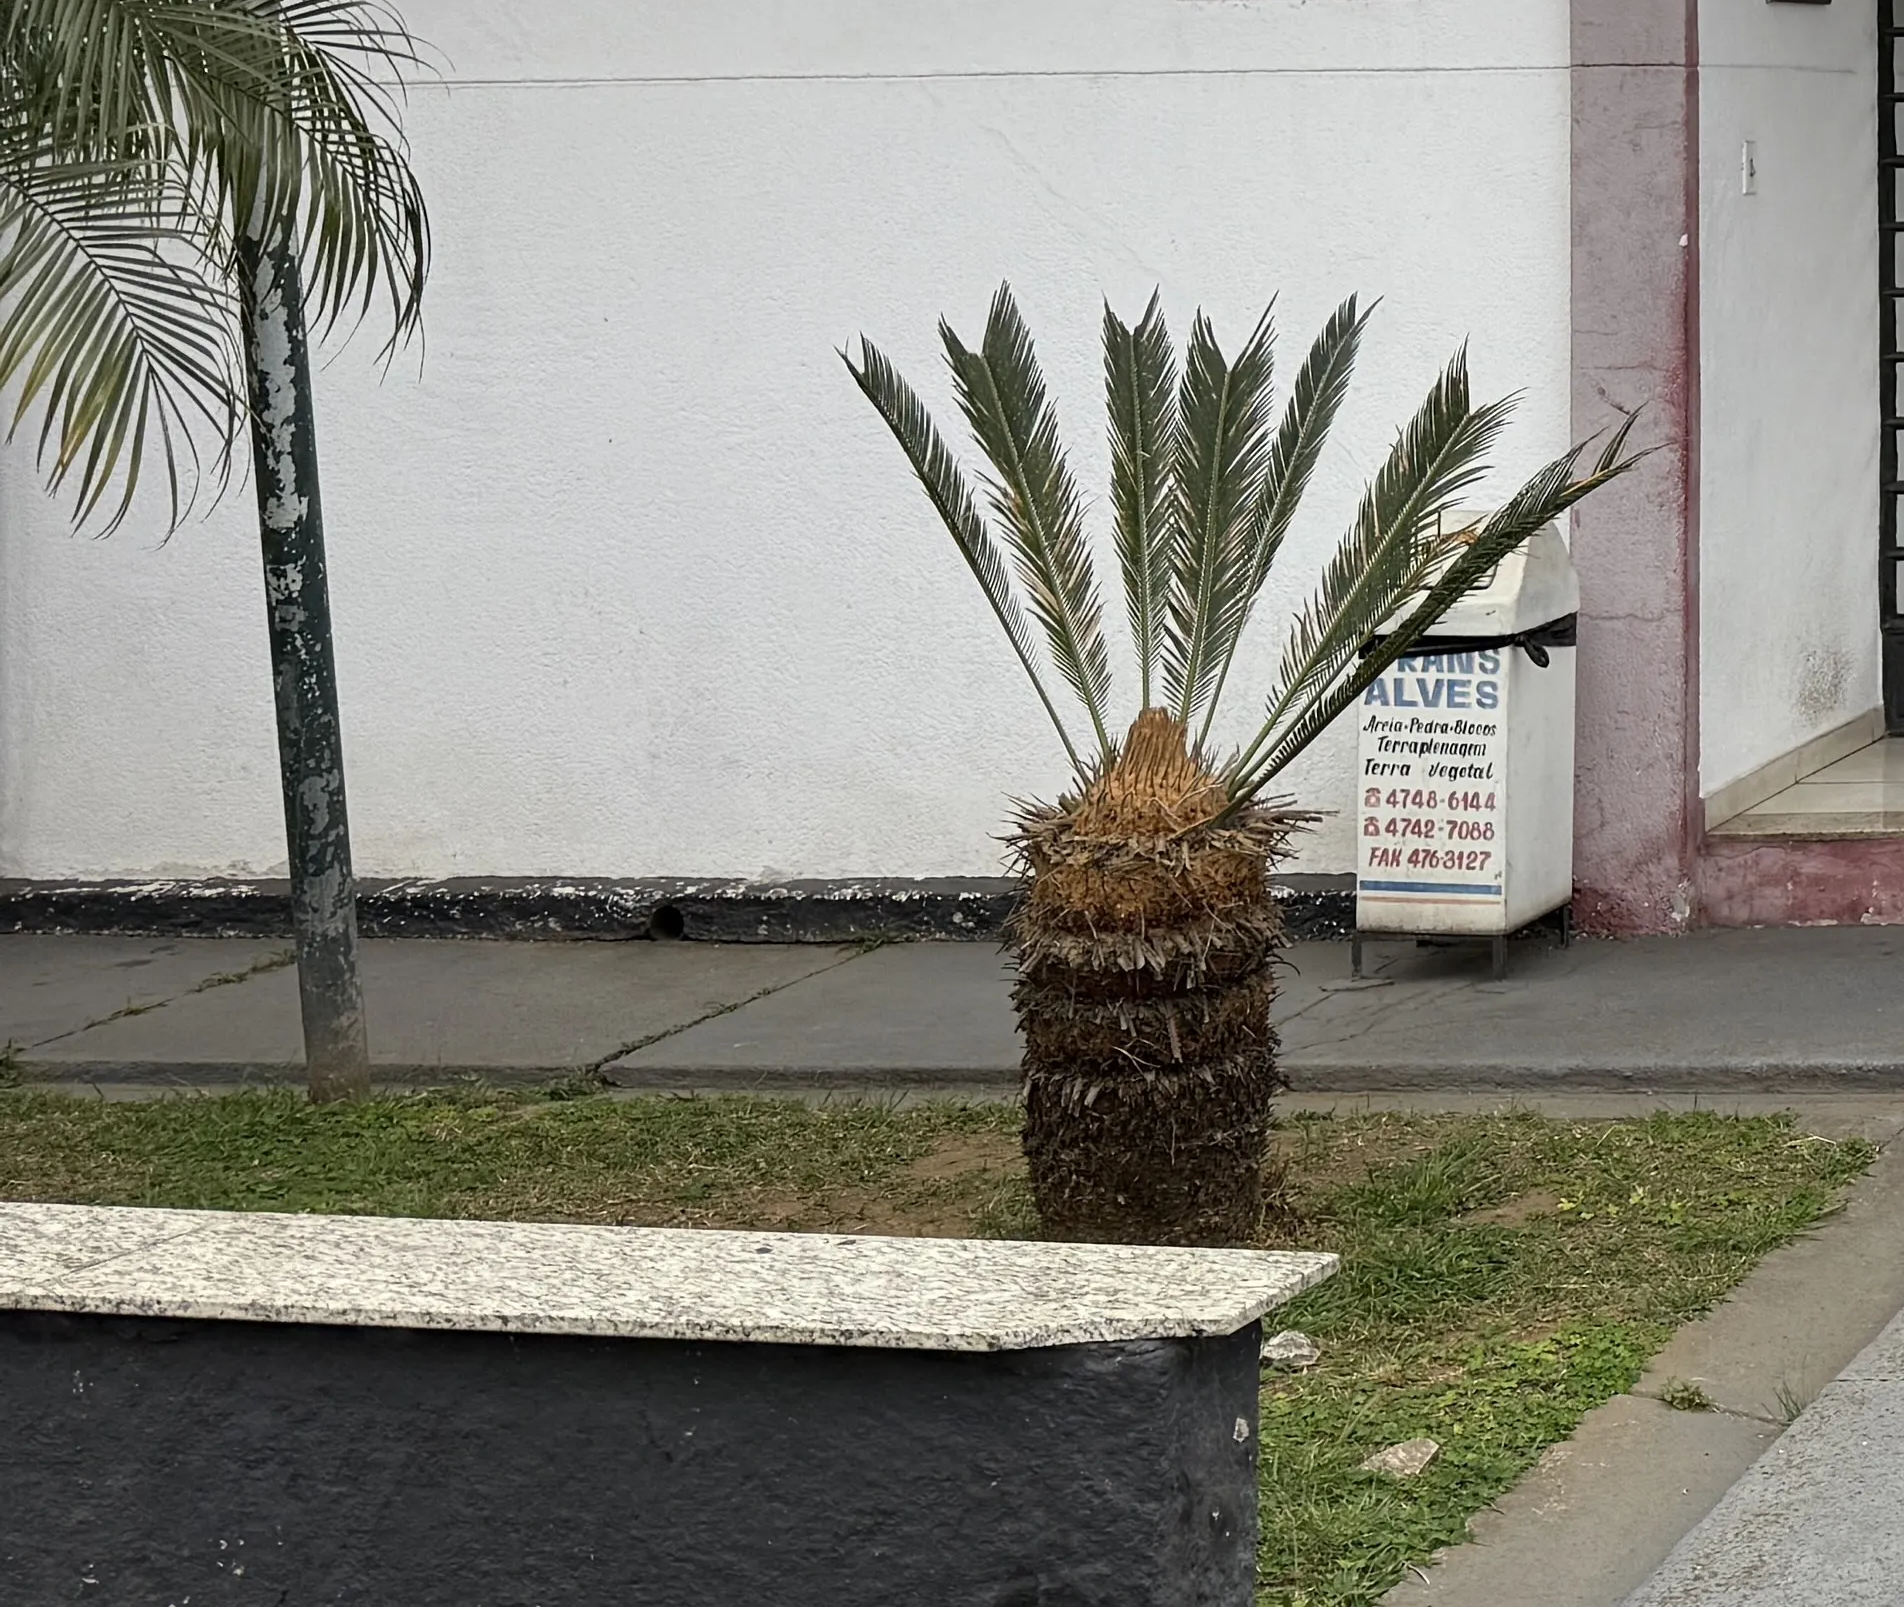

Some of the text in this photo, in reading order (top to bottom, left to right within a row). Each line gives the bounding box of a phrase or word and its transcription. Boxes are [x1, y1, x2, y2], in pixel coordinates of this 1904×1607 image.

[1364, 678, 1499, 709] ALVES
[1378, 736, 1487, 758] Terraplenagem
[1365, 758, 1411, 776] Terra
